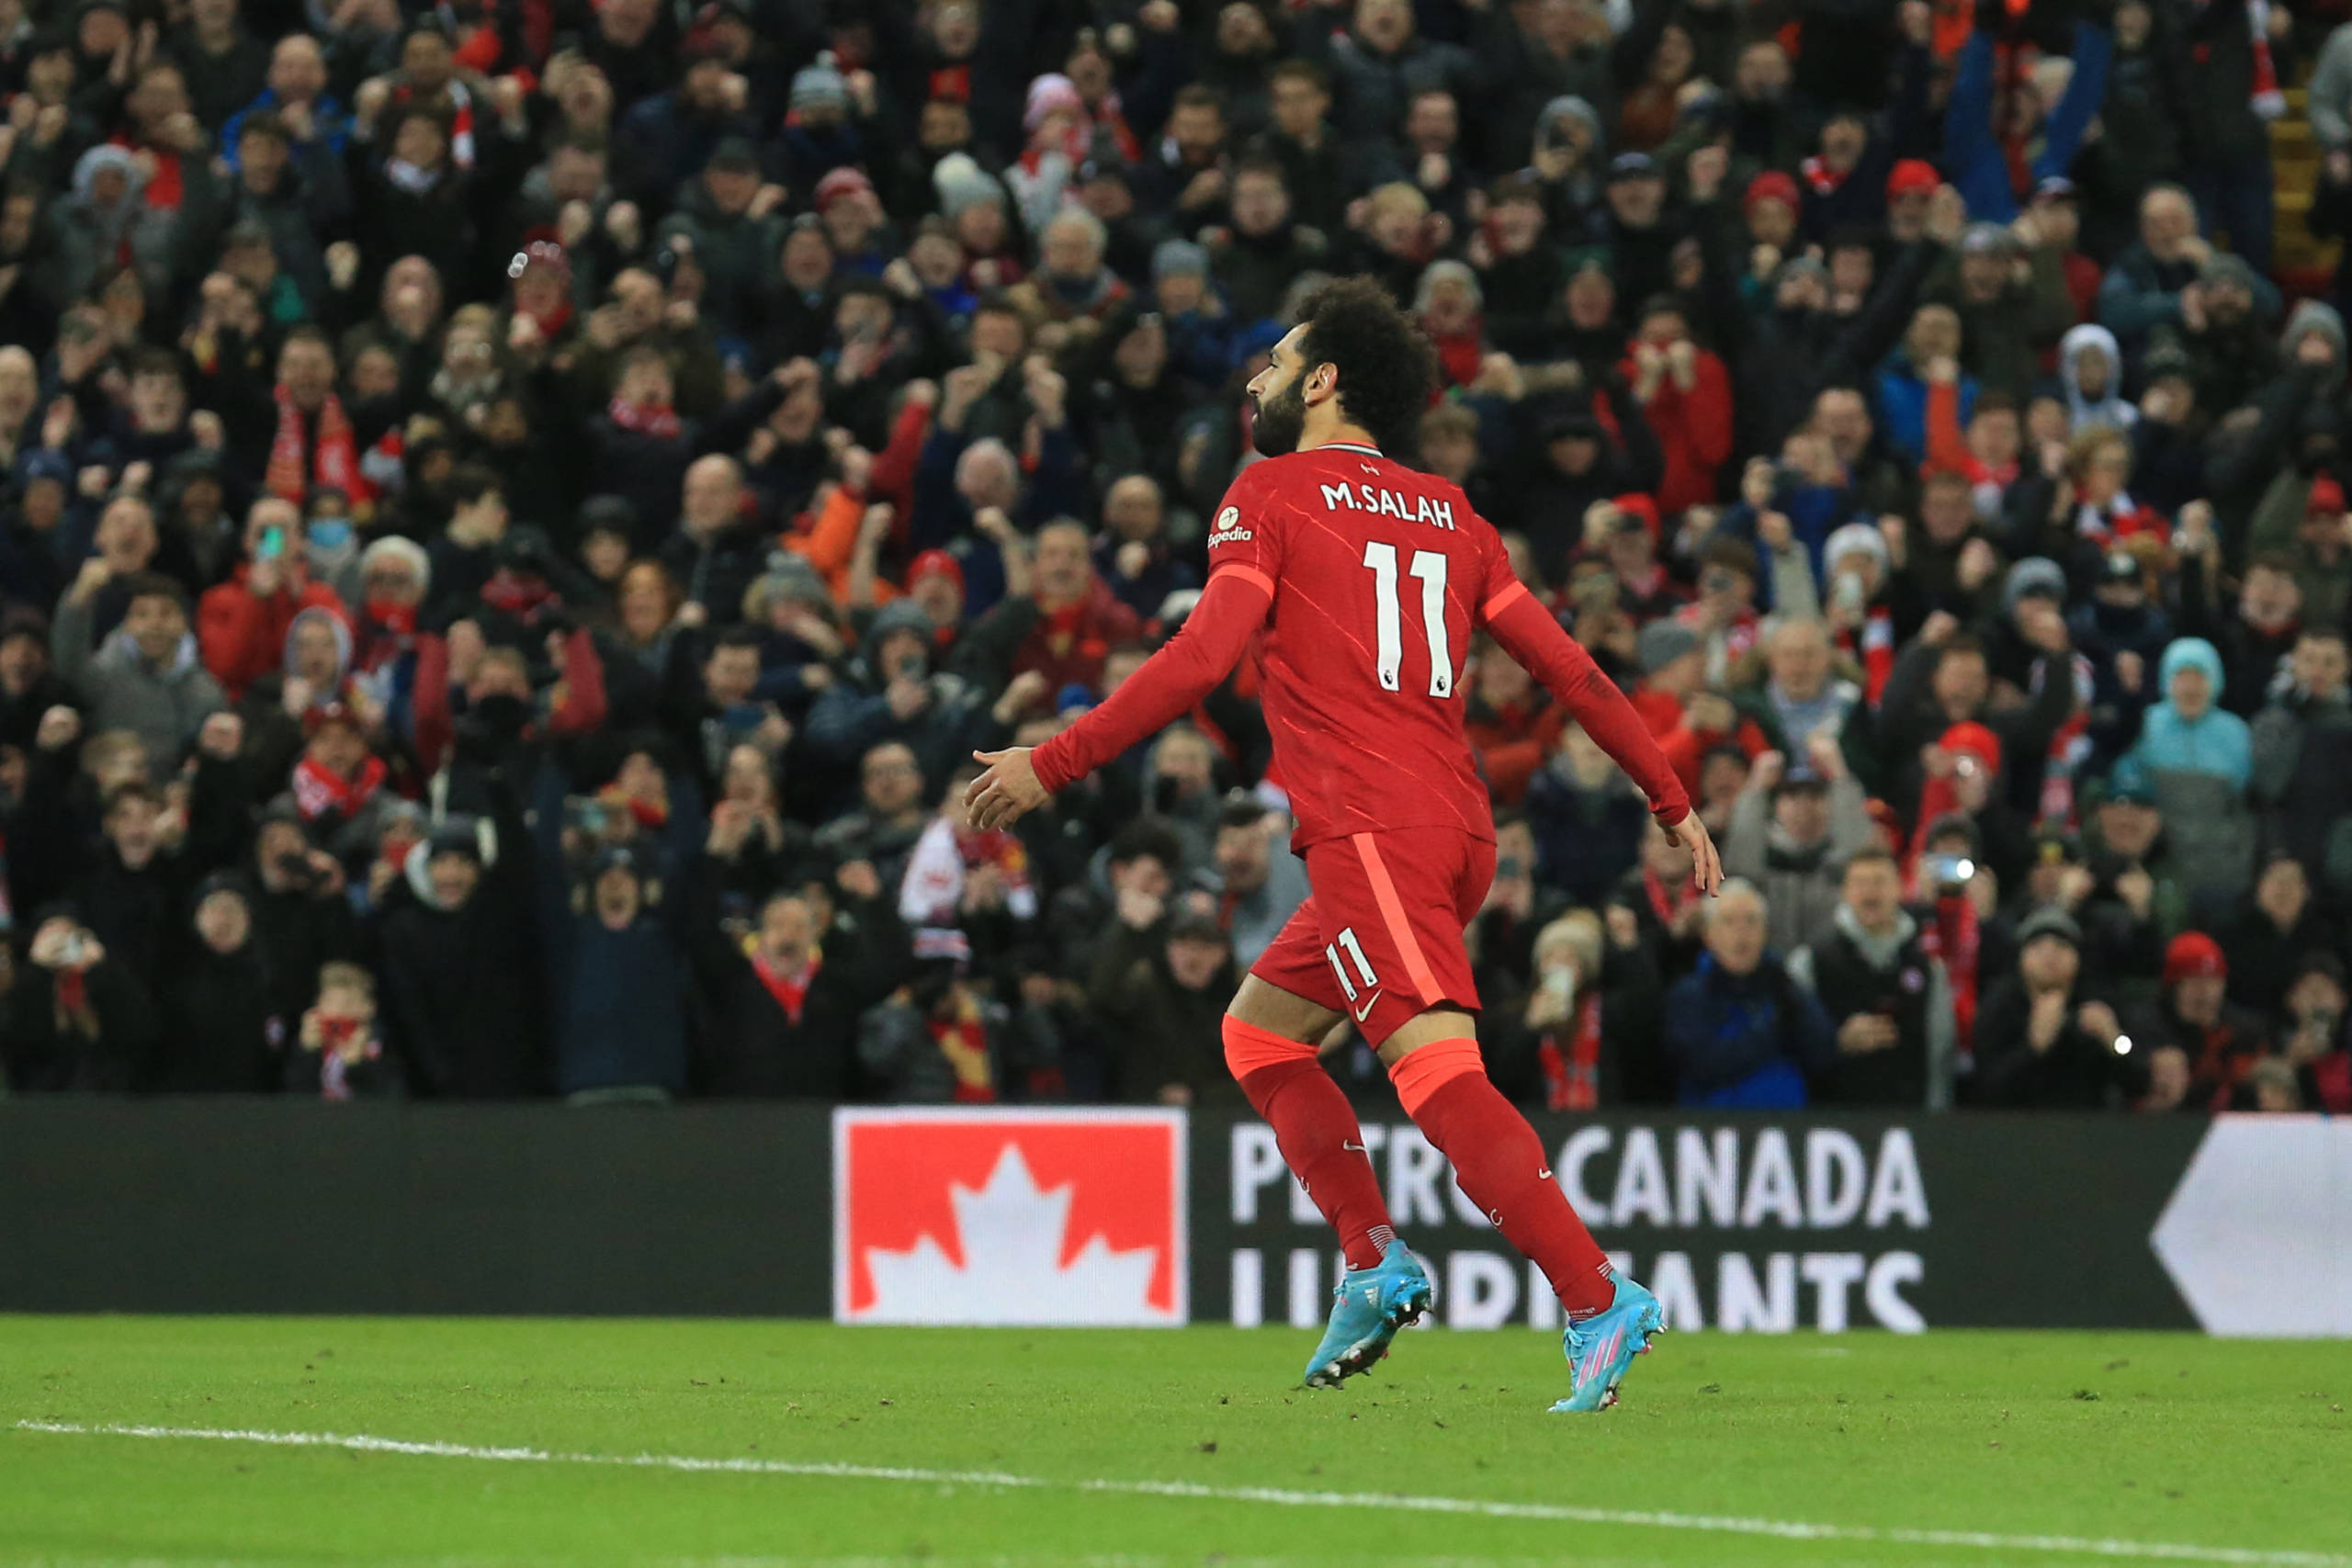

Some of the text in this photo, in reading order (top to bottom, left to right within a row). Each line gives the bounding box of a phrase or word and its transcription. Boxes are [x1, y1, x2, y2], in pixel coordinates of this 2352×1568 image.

[1319, 481, 1455, 531] M.SALAH
[1363, 540, 1453, 699] 11
[1325, 926, 1379, 1002] 11
